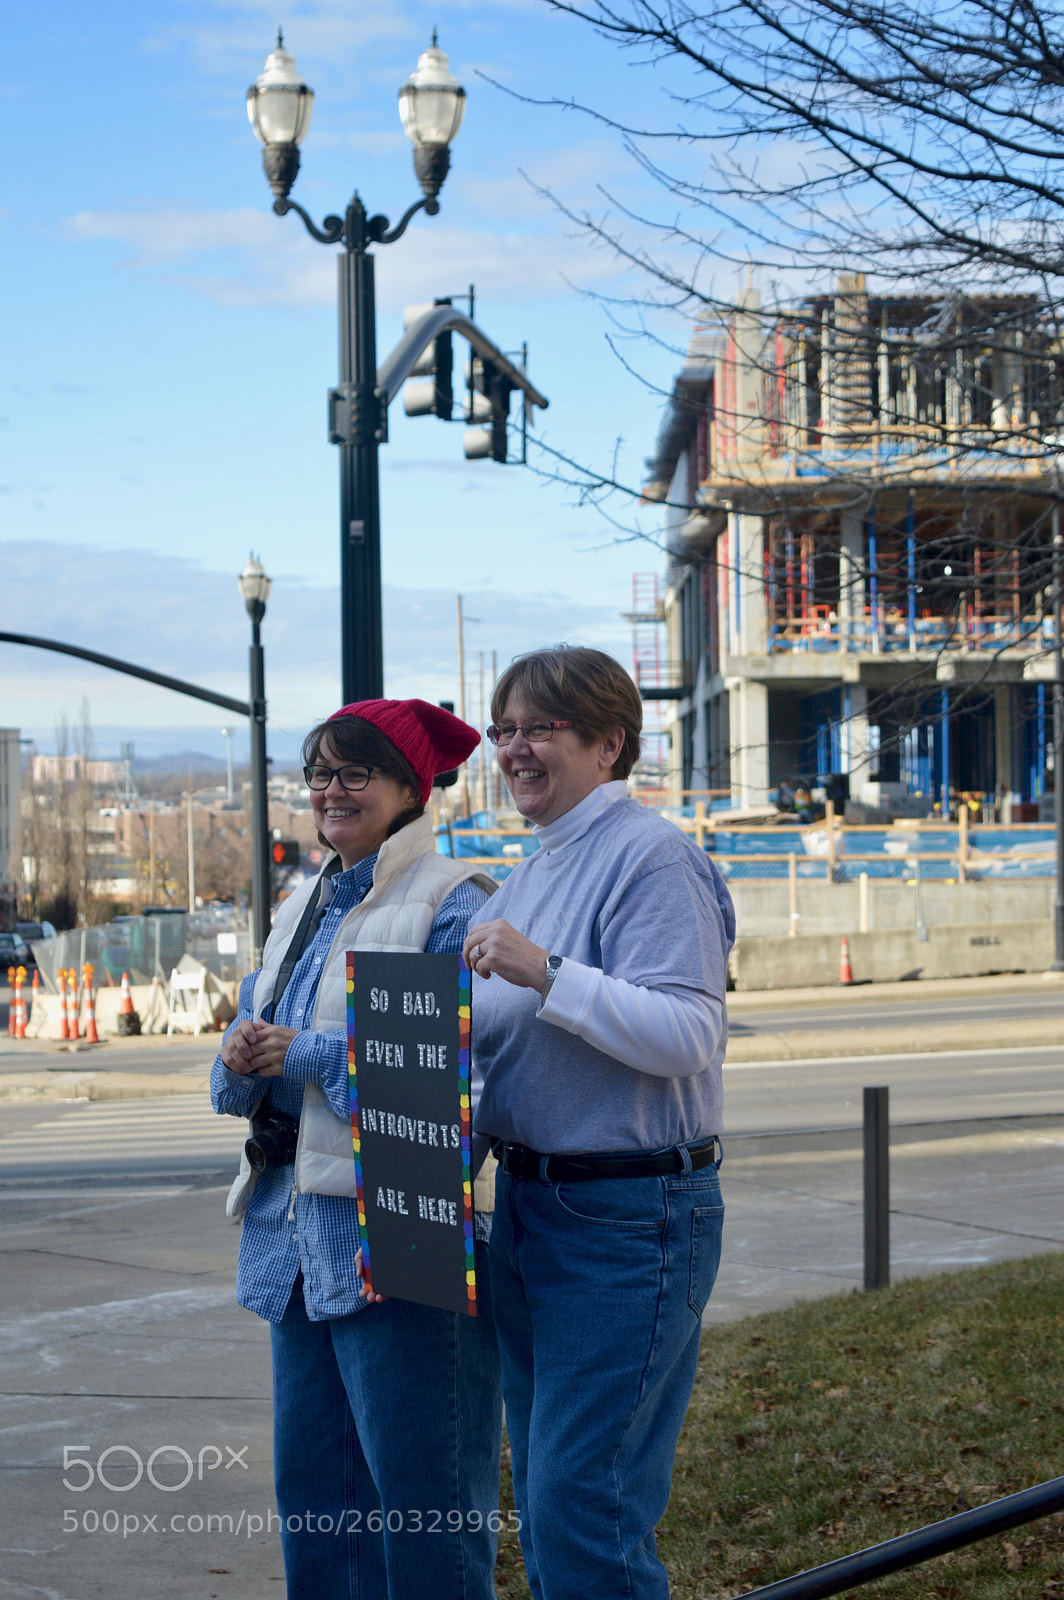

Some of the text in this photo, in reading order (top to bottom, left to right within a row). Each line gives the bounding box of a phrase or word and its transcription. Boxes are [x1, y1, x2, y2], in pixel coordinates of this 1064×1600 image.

[370, 987, 441, 1018] SO BAD,
[365, 1039, 448, 1070] EVEN THE
[361, 1107, 461, 1149] INTROVERTS
[376, 1185, 458, 1227] ARE HERE
